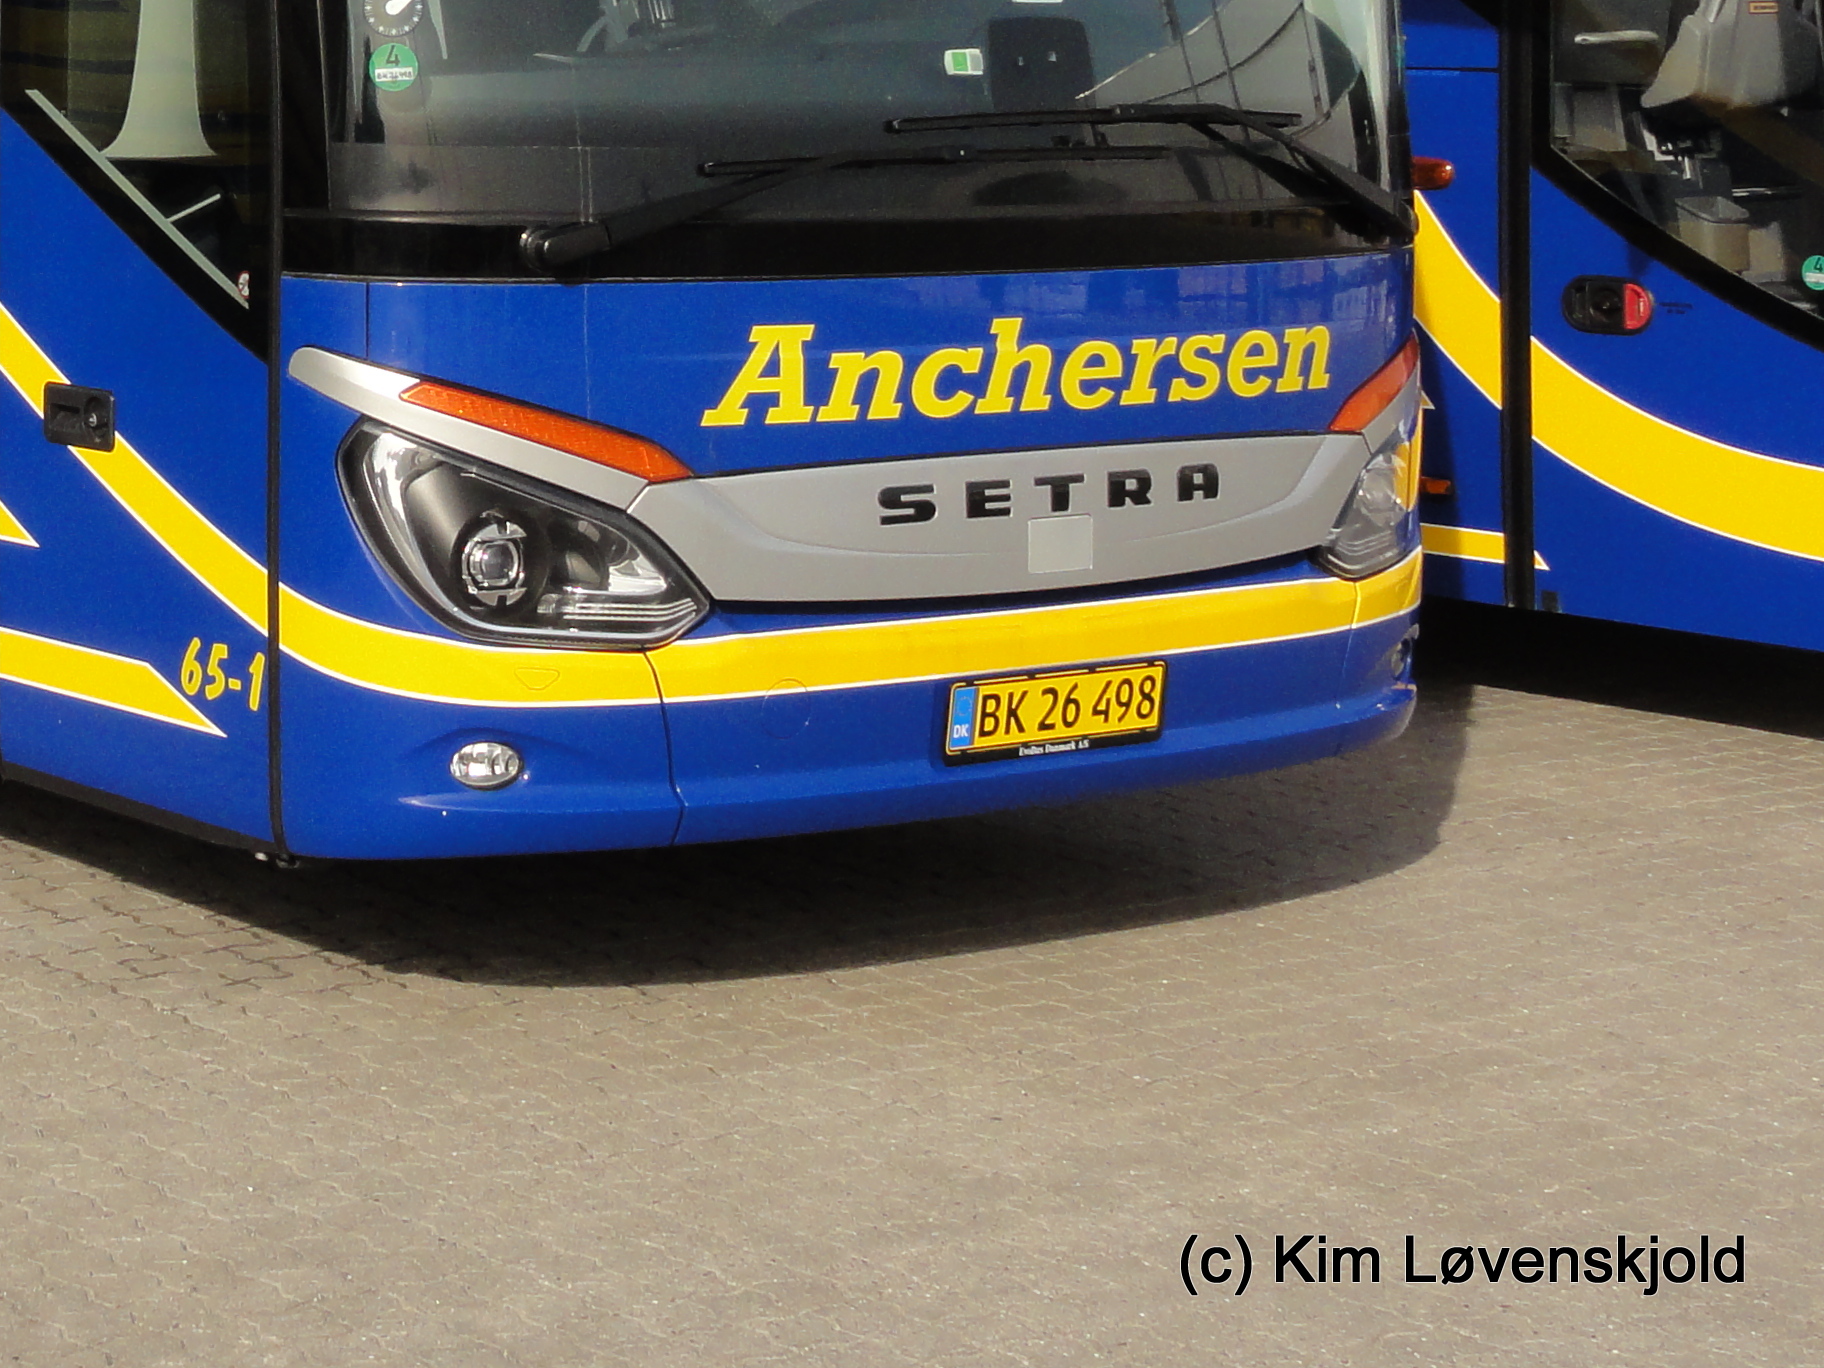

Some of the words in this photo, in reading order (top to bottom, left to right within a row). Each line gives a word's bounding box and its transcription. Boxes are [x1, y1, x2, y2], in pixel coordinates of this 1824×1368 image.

[386, 44, 400, 67] 4
[701, 317, 1331, 428] Anchersen
[877, 463, 1220, 525] SETRA
[181, 637, 265, 712] 65-1
[953, 724, 969, 739] DK
[978, 690, 1028, 738] BK
[1037, 682, 1081, 732] 26
[1091, 675, 1157, 724] 498
